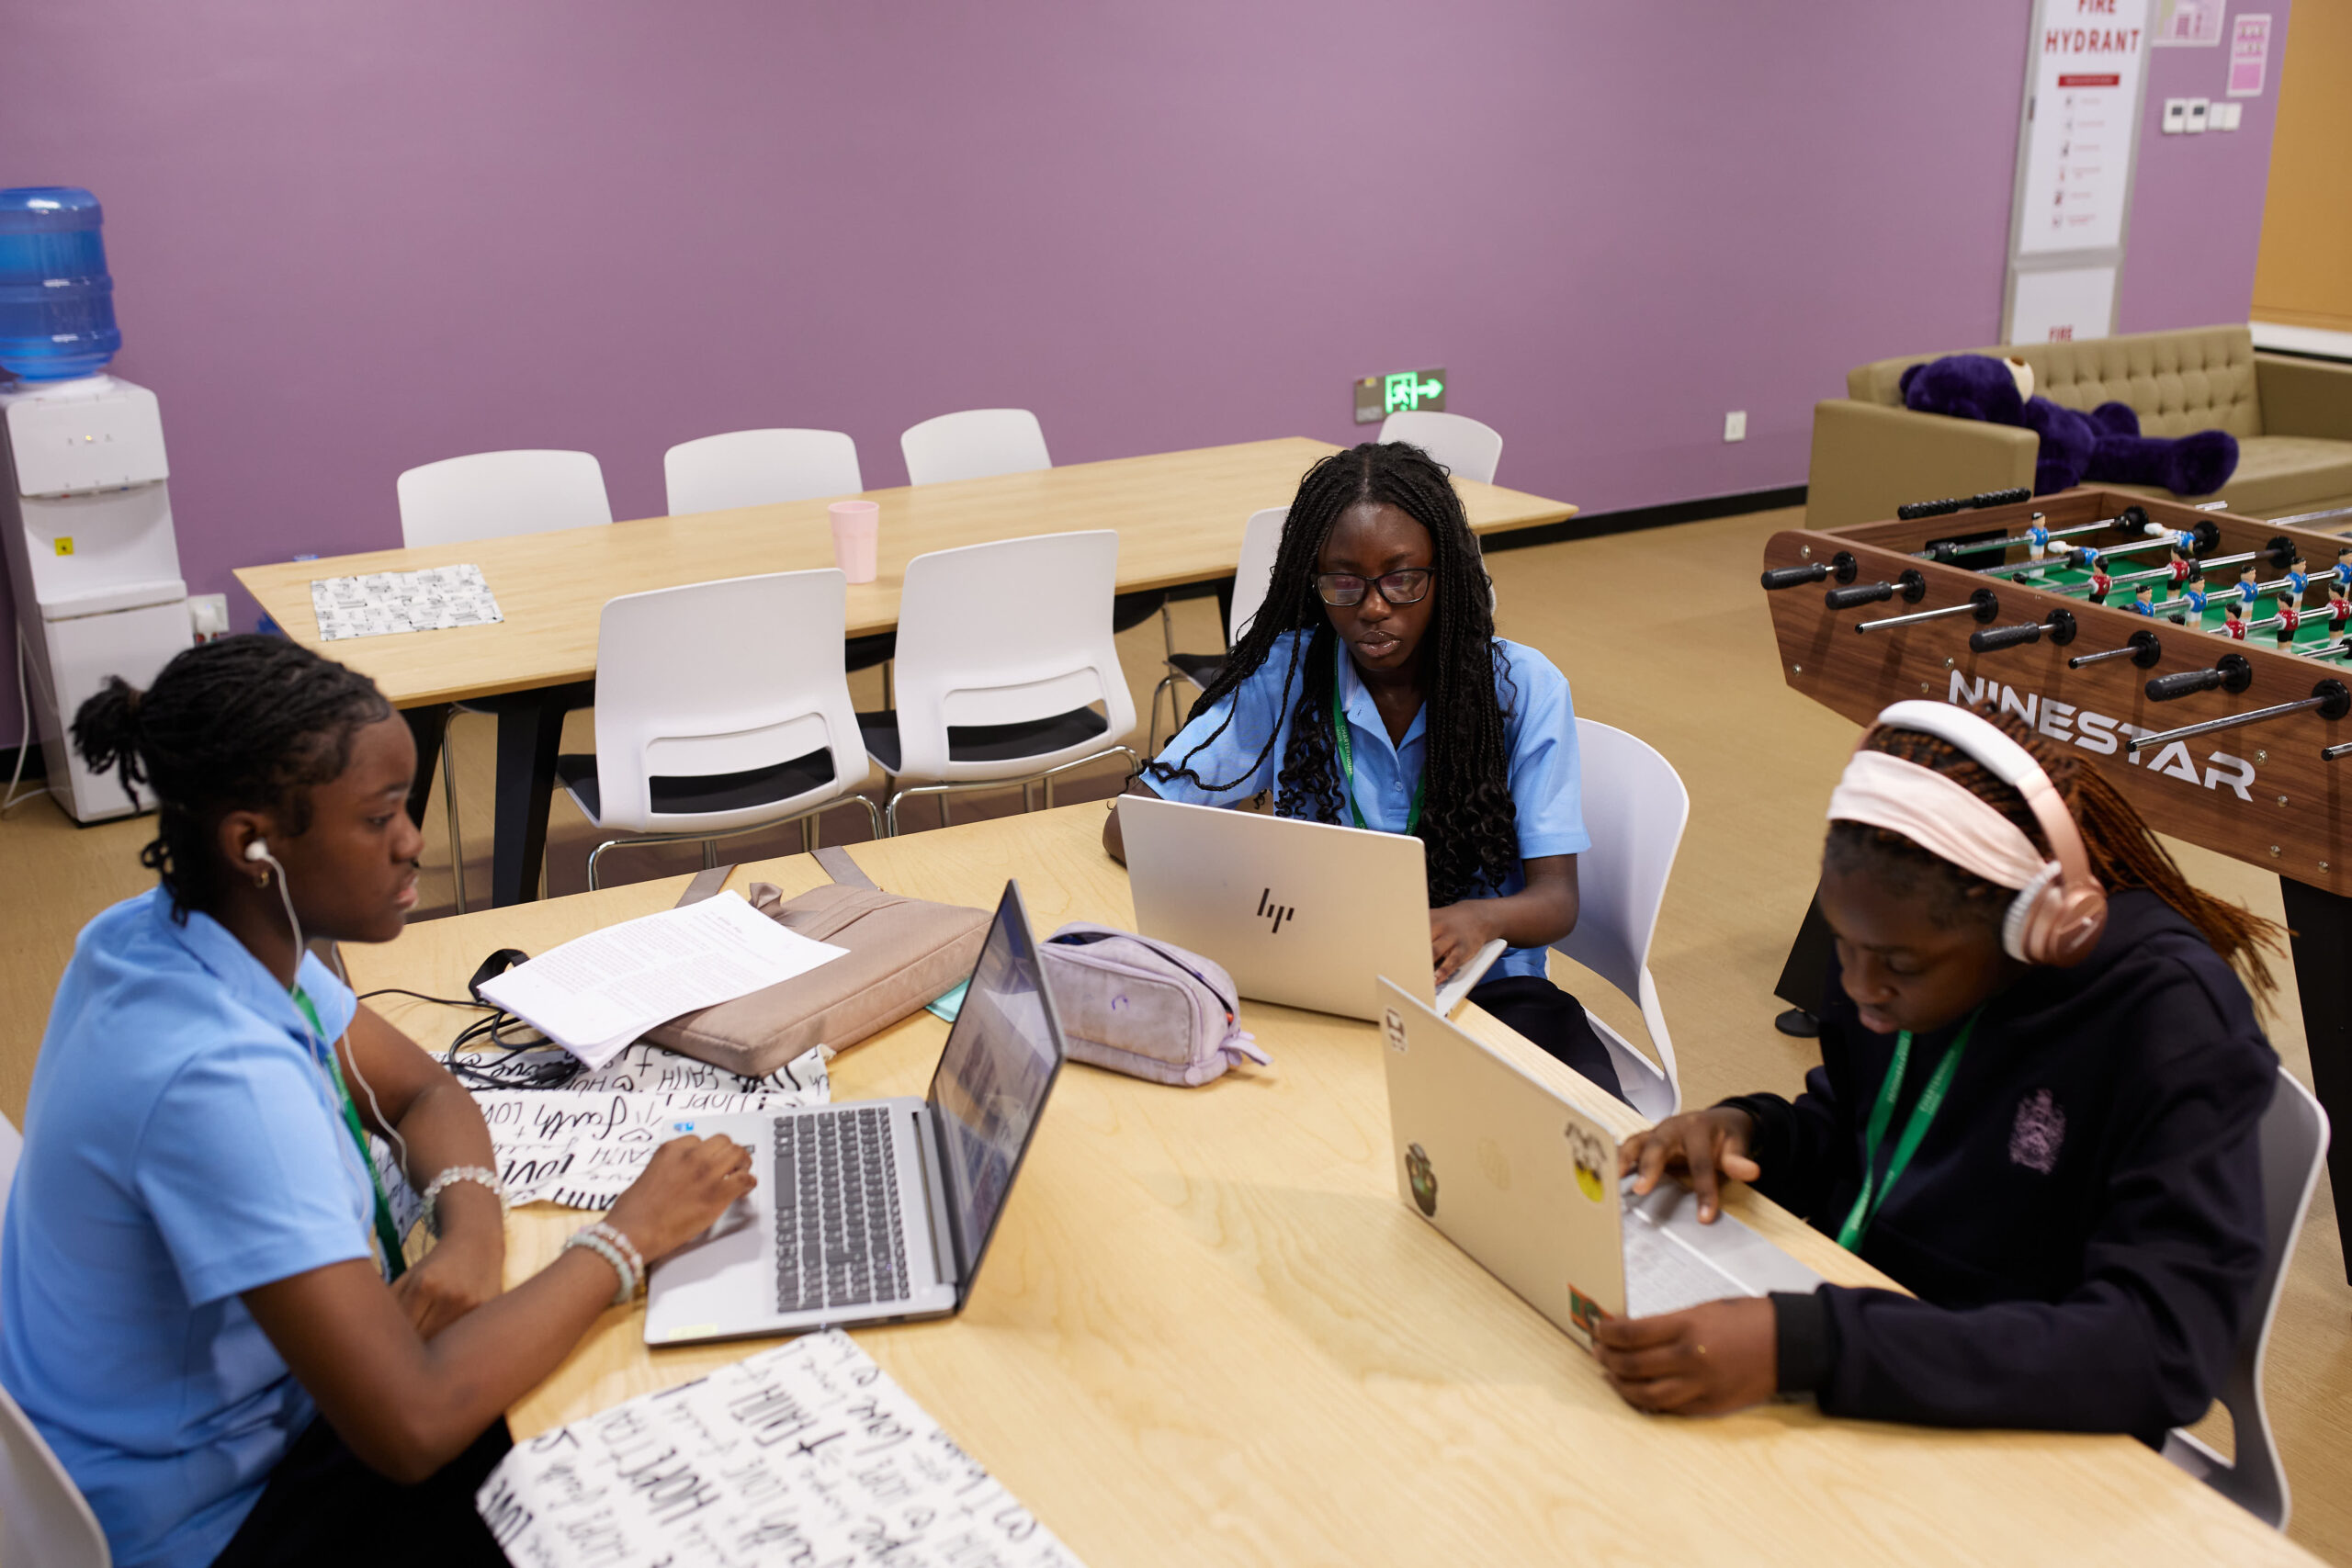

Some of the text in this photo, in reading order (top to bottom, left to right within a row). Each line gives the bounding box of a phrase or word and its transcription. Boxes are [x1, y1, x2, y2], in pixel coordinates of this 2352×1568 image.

[2044, 28, 2140, 53] HYDRANT
[1948, 669, 2256, 803] NINESTAR
[656, 1065, 719, 1092] FAITH
[483, 1101, 523, 1126] LOV
[534, 1096, 627, 1141] faith
[729, 1383, 820, 1450] FAITH
[616, 1448, 722, 1529] HOPE
